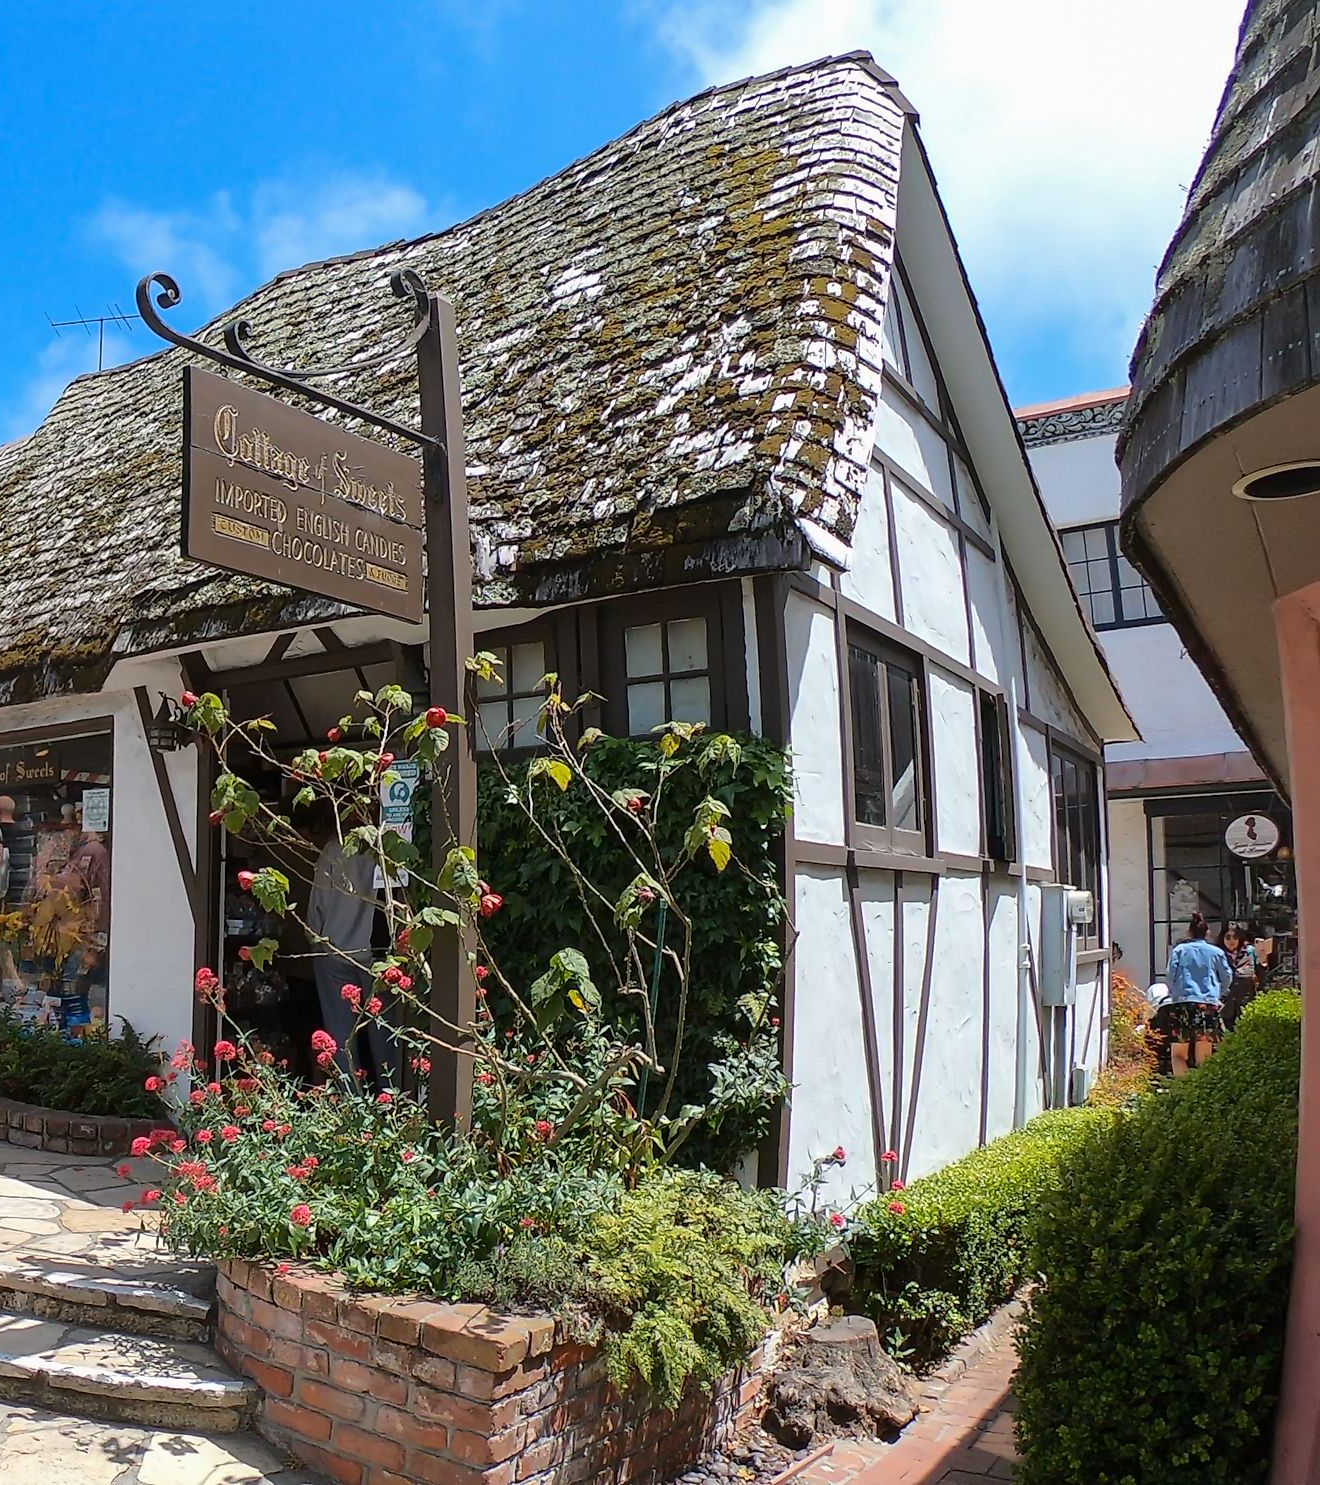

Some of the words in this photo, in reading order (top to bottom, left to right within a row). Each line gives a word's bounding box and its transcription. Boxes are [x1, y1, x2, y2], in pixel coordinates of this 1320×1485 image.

[214, 405, 310, 492] Cottage
[314, 453, 328, 505] of
[333, 450, 407, 521] Sweets
[215, 477, 288, 524] IMPORTED
[296, 505, 350, 546] ENGLISH
[354, 528, 407, 566] CANDIES
[220, 519, 266, 541] CUSTOM
[271, 529, 365, 581] CHOCOLATES
[0, 763, 11, 784] of
[16, 761, 55, 779] Sweets
